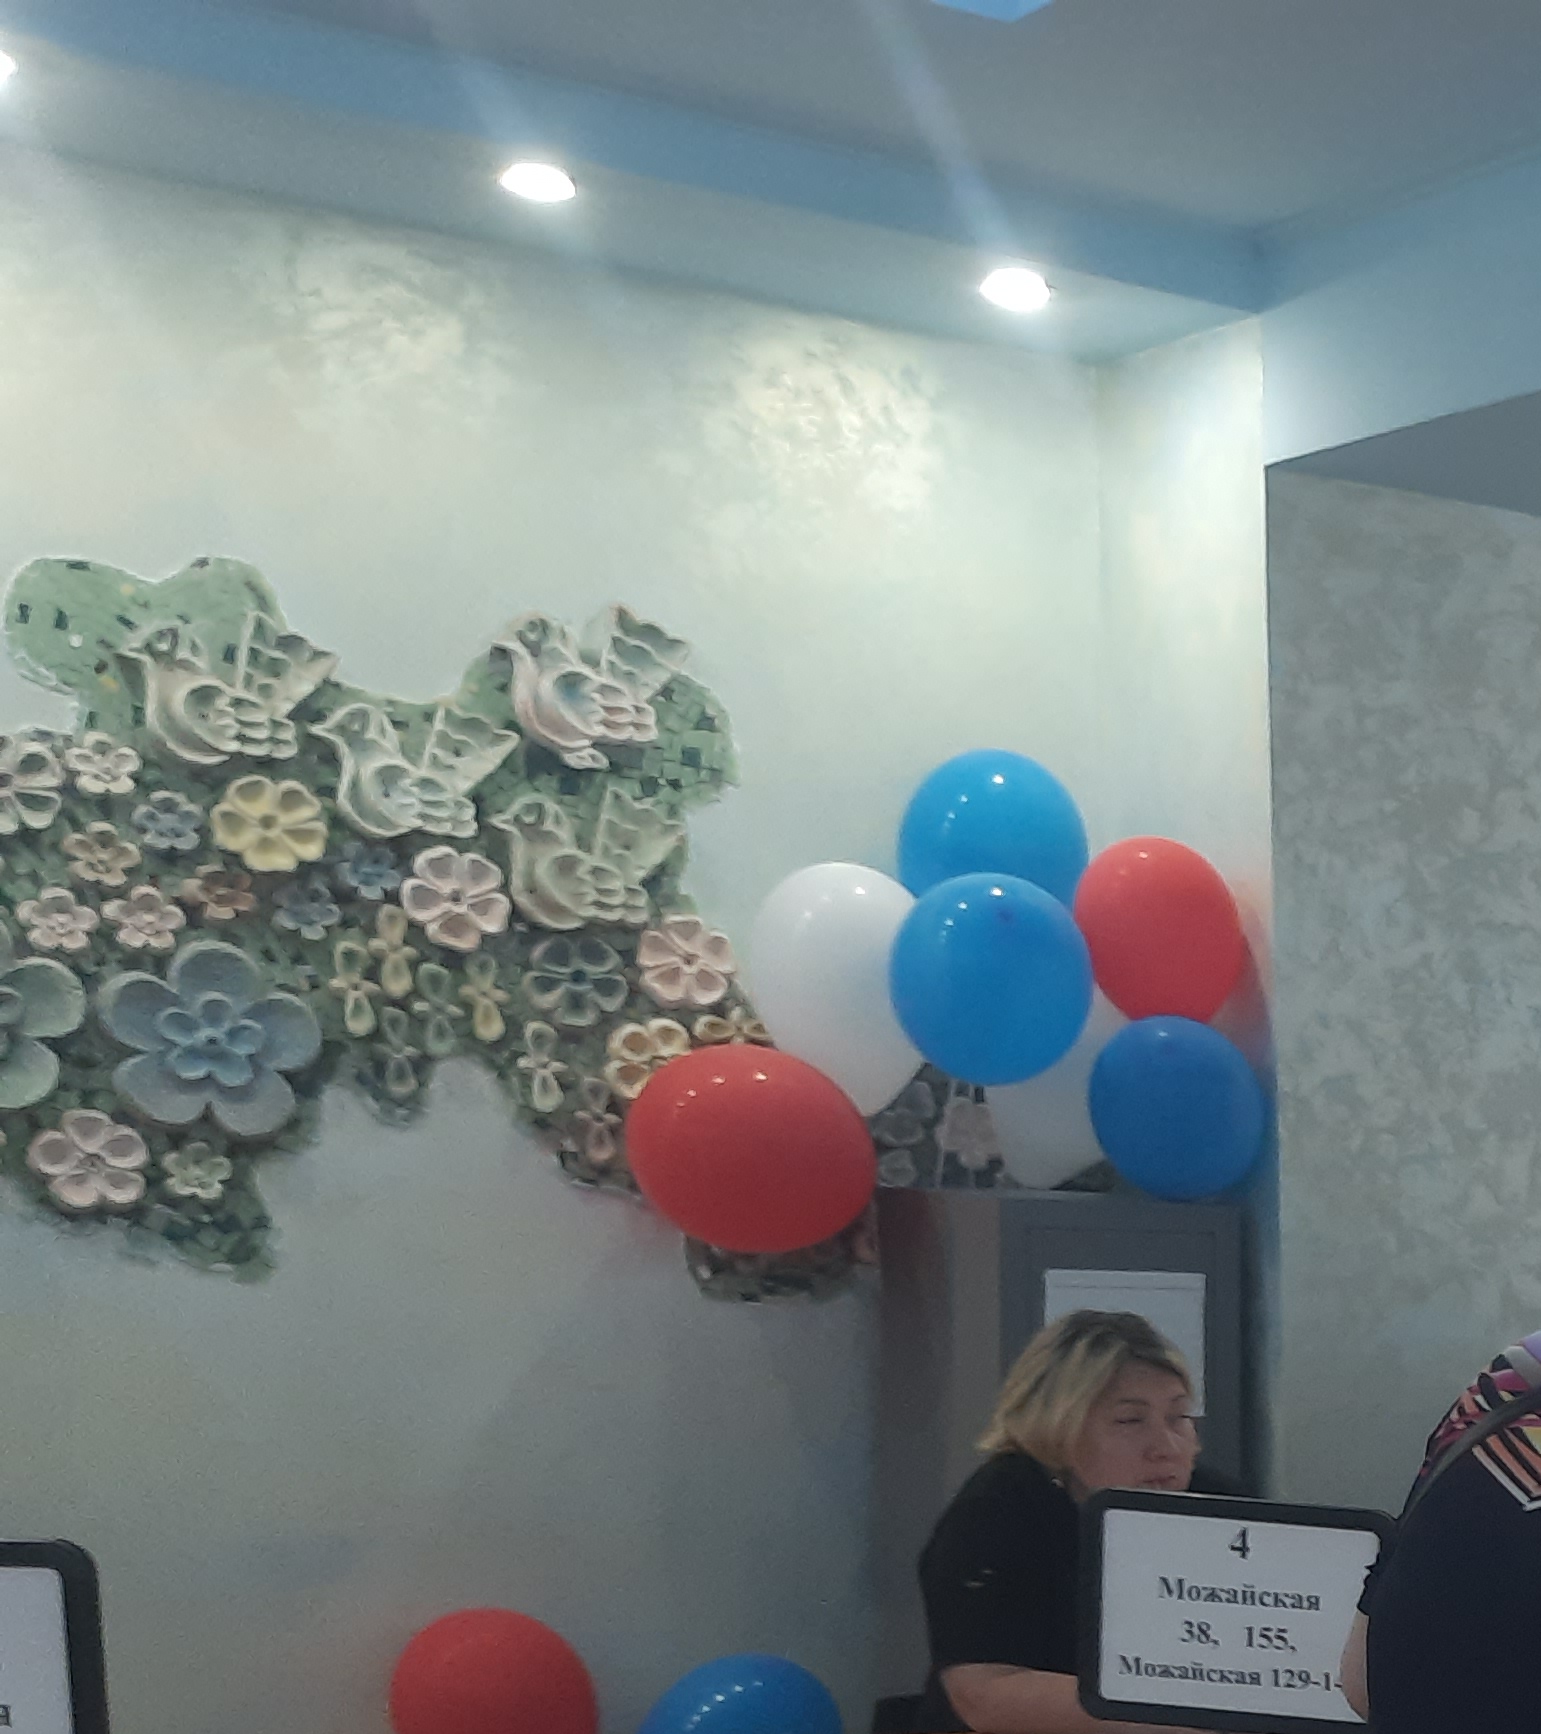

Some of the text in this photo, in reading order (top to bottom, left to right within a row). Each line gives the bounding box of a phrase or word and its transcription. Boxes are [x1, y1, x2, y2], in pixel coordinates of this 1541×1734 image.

[1228, 1527, 1250, 1560] 4
[1158, 1575, 1321, 1612] Можайская
[1180, 1619, 1297, 1653] 38, 155,
[1118, 1654, 1262, 1686] Можайская
